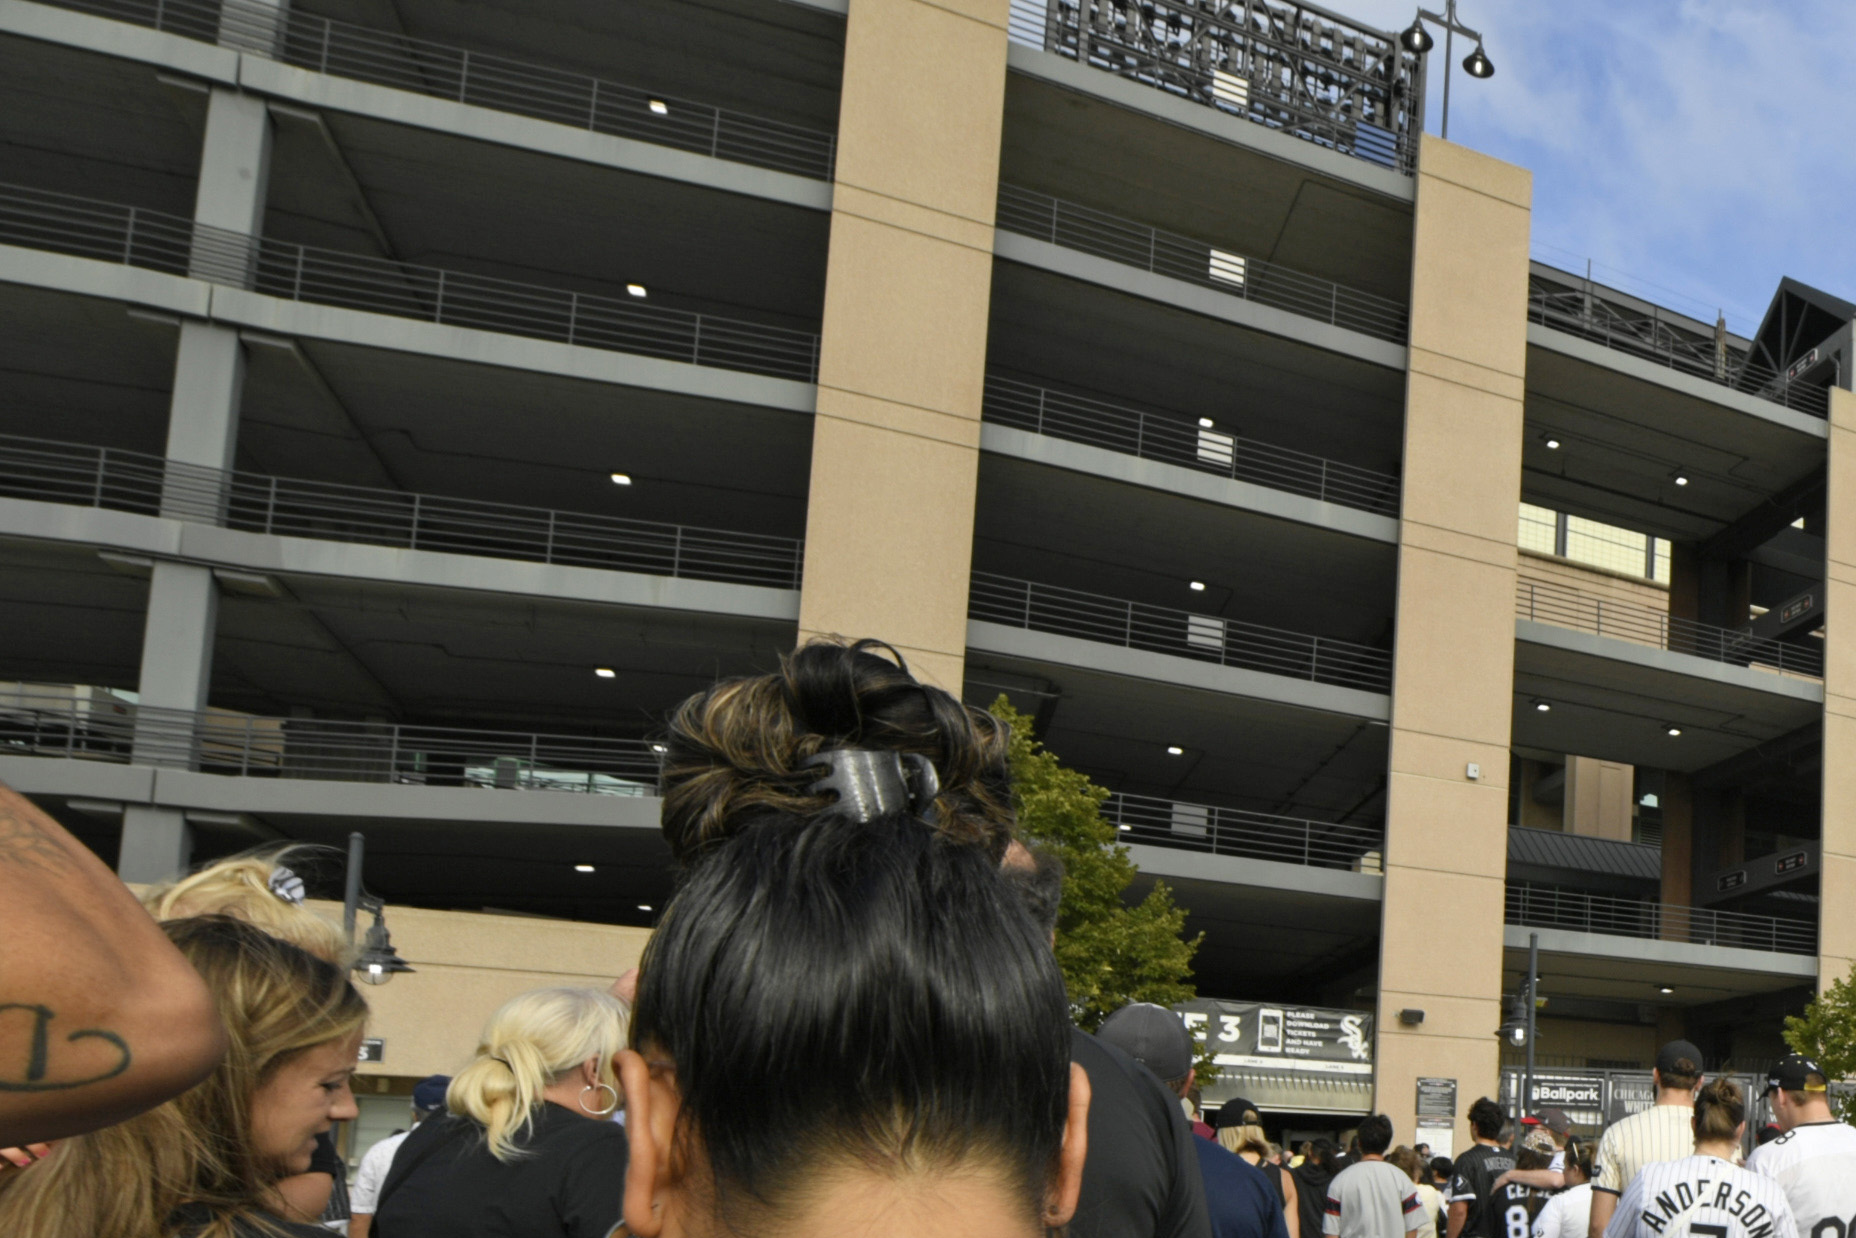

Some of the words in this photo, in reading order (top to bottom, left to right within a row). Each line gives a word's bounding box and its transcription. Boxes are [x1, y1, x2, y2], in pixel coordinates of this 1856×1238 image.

[1286, 1011, 1315, 1019] PLEASE
[1218, 1014, 1240, 1042] 3
[1286, 1020, 1329, 1029] DOWNLOAD
[1286, 1029, 1317, 1037] TICKETS
[1303, 1039, 1323, 1047] HAVE
[1285, 1047, 1310, 1055] READY
[1540, 1086, 1598, 1102] Ballpark
